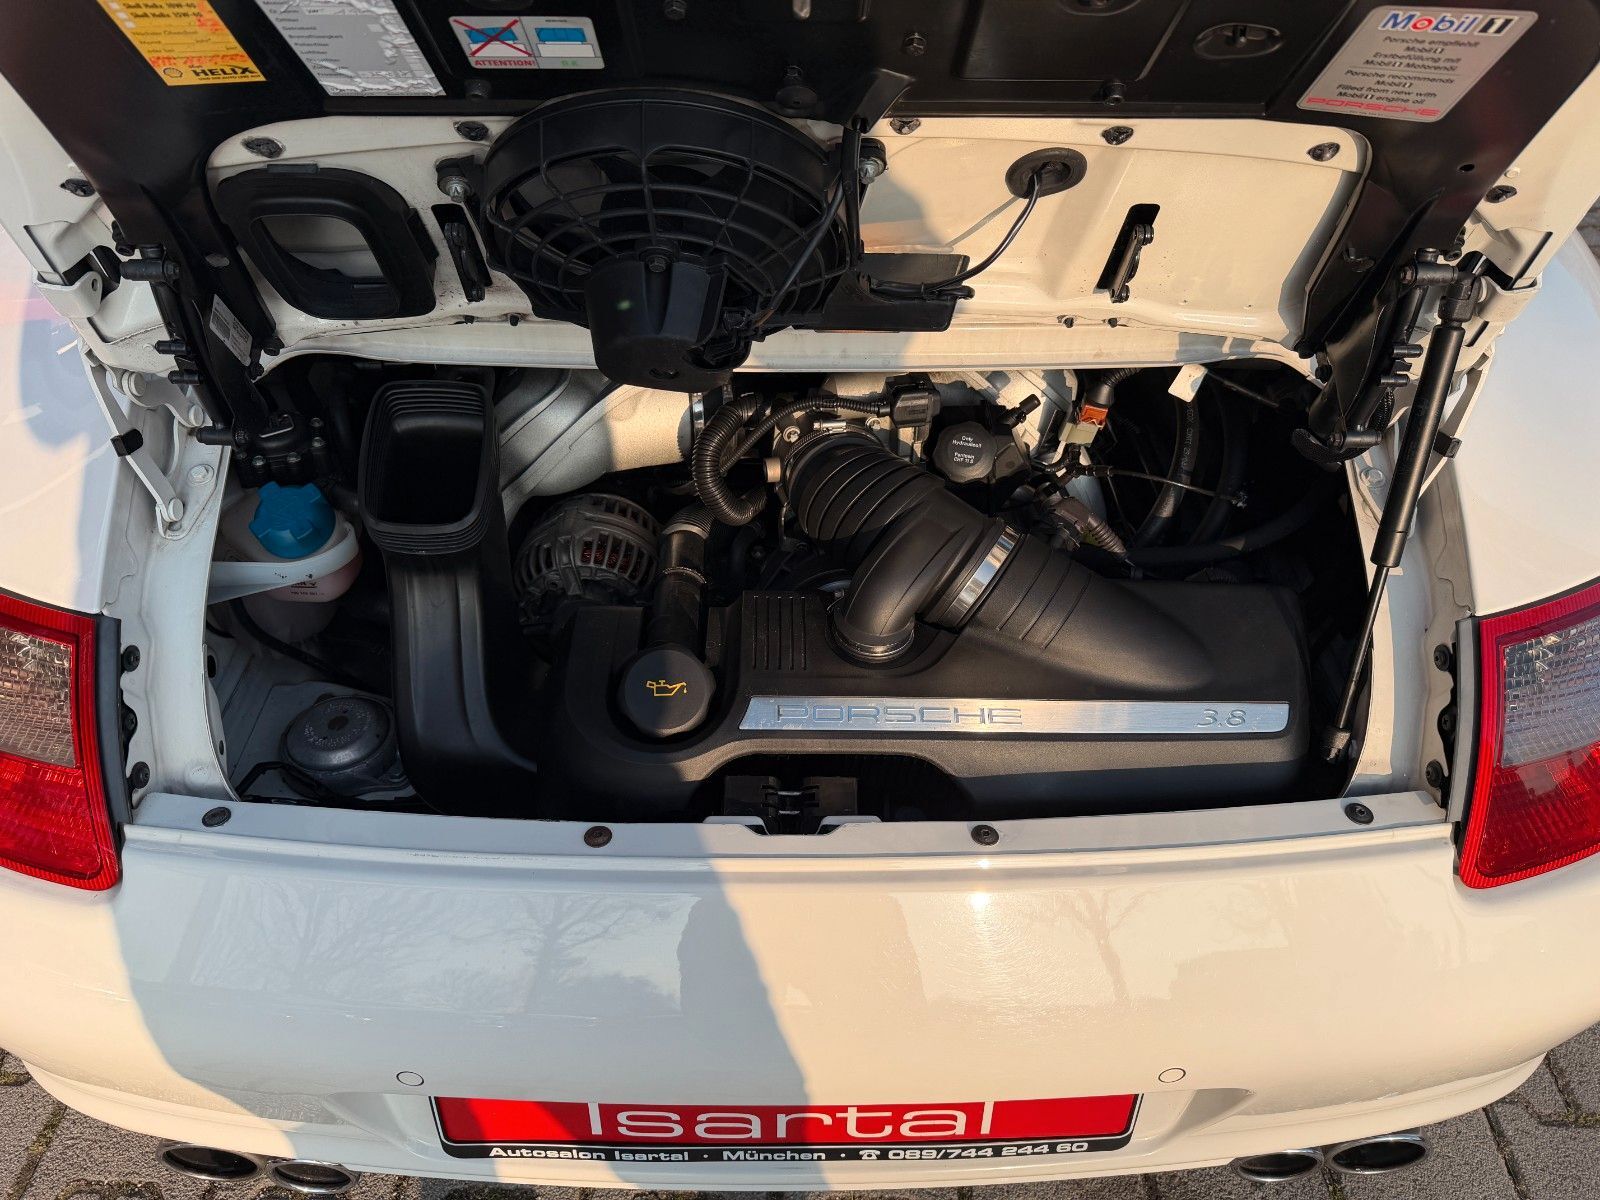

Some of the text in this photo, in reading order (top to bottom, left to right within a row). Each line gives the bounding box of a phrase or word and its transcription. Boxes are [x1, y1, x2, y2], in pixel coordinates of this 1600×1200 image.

[1382, 12, 1478, 33] Mobil
[1383, 36, 1426, 44] Porsche
[191, 66, 257, 77] HELIX
[1344, 70, 1454, 84] Porsche recommends
[1365, 86, 1390, 94] from
[1306, 96, 1441, 116] PORSCHE
[1375, 95, 1410, 104] engine
[777, 704, 1247, 728] PORSCHE 3.8
[588, 1101, 995, 1139] Isartal
[488, 1142, 1089, 1161] Autosalon Isartal München 089/744 244 60
